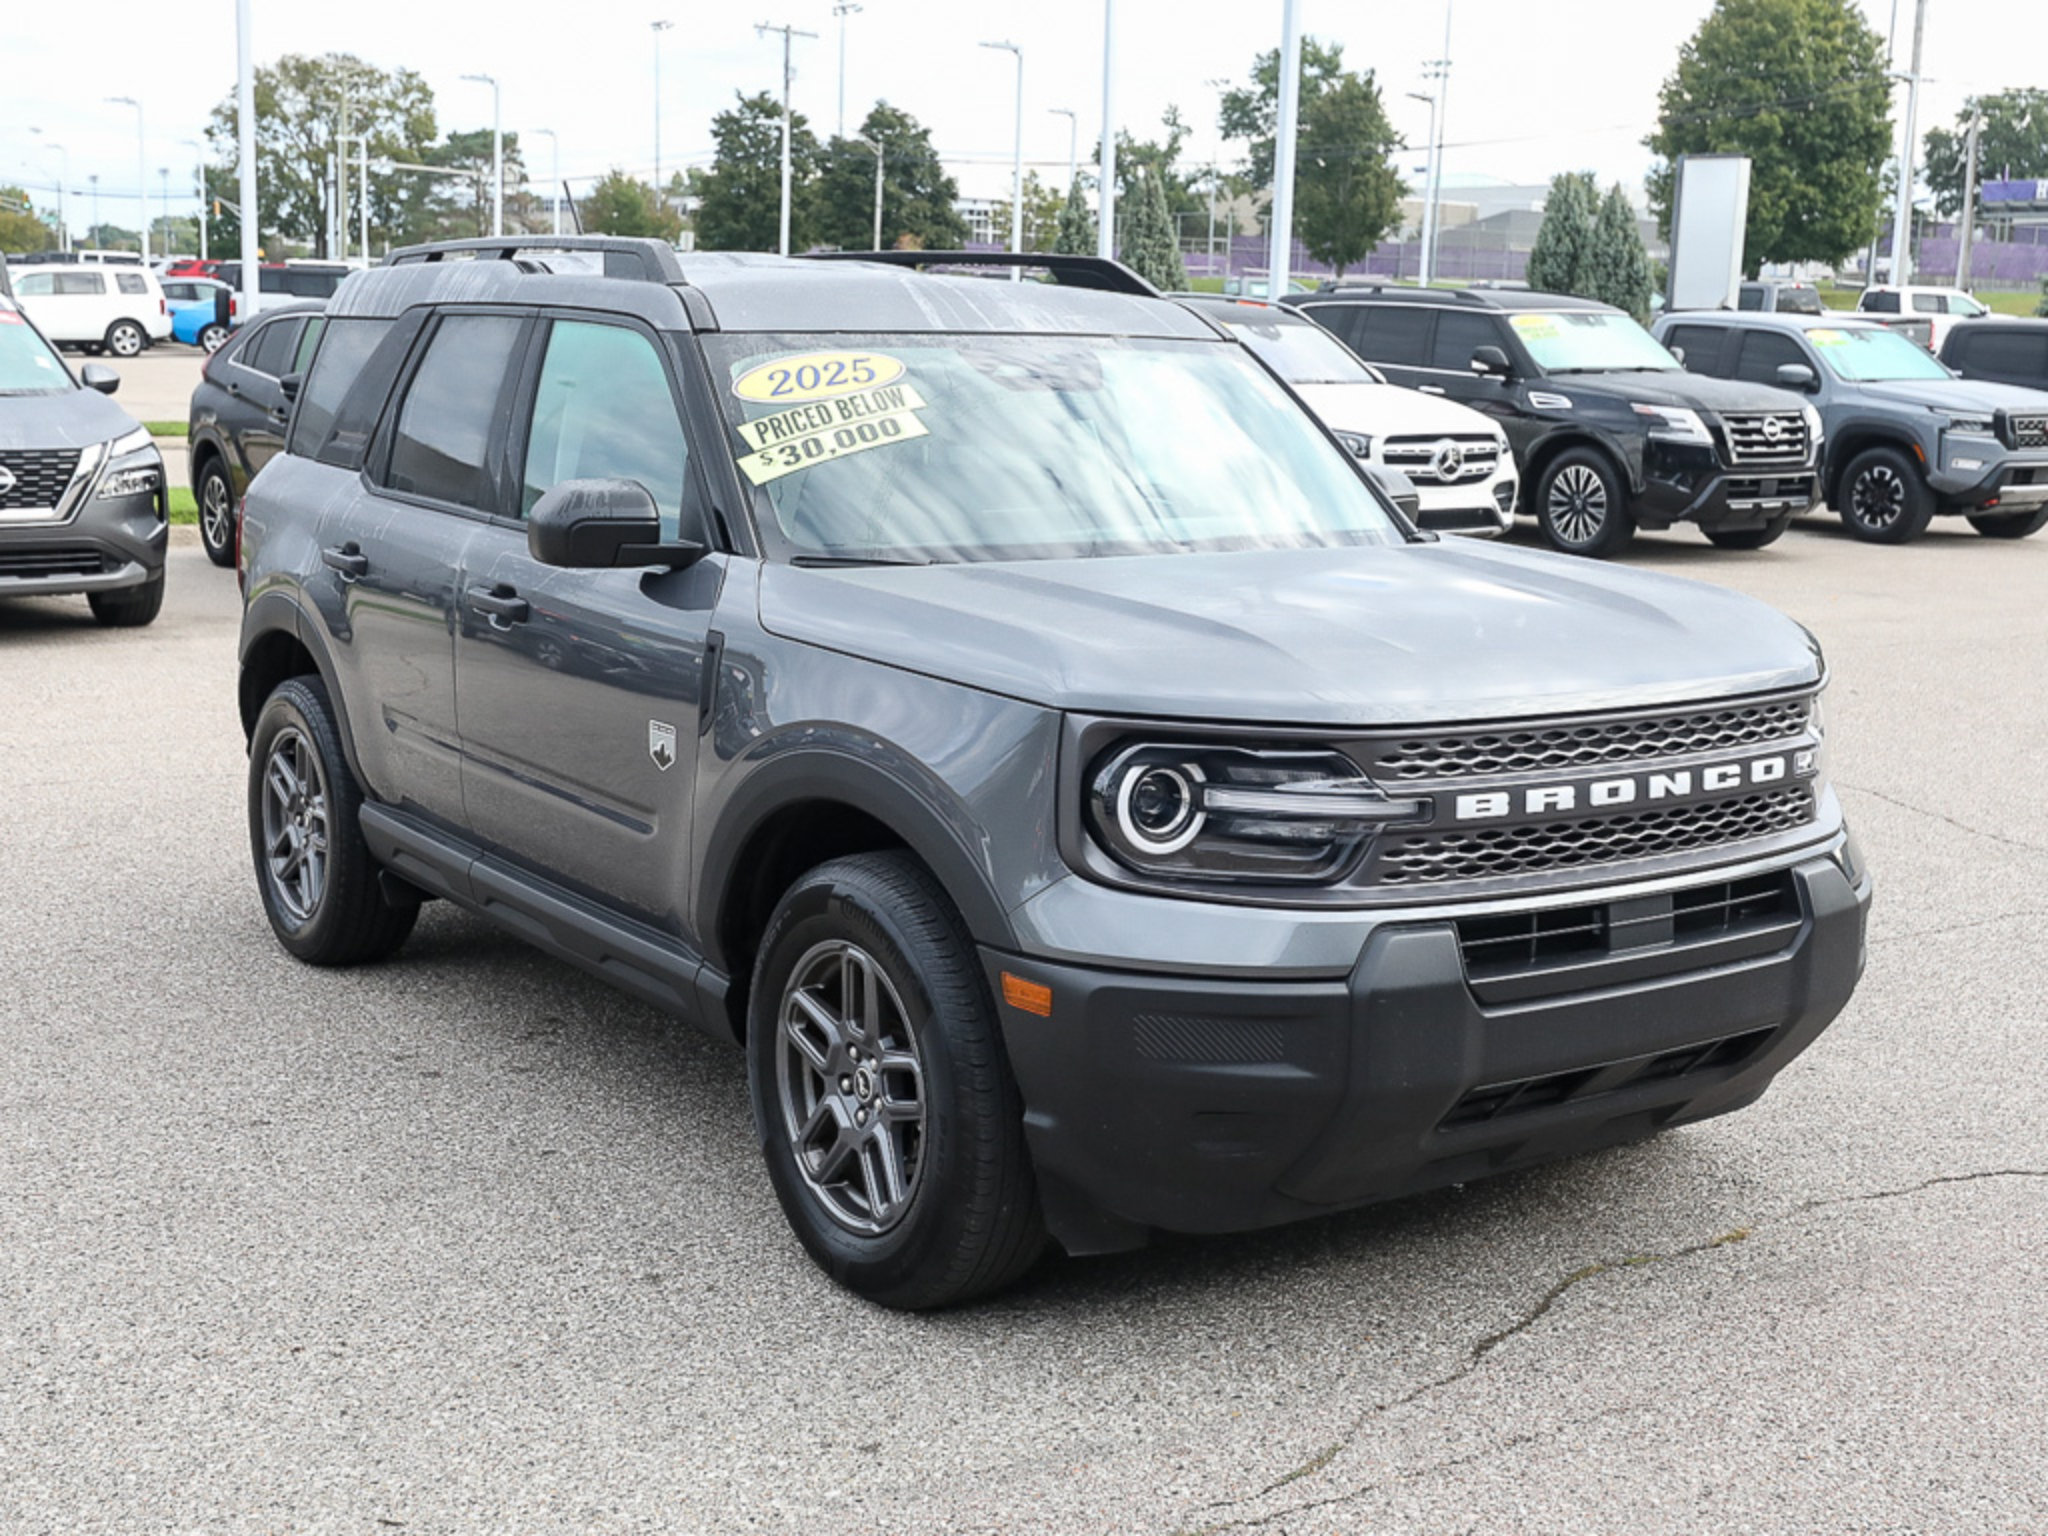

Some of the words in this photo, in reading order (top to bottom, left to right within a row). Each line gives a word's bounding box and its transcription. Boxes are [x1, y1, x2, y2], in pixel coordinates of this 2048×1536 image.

[767, 357, 876, 397] 2025
[753, 402, 833, 445] PRICED
[835, 387, 907, 421] BELOW
[759, 417, 901, 467] $30,000
[1455, 756, 1785, 820] BRONCO
